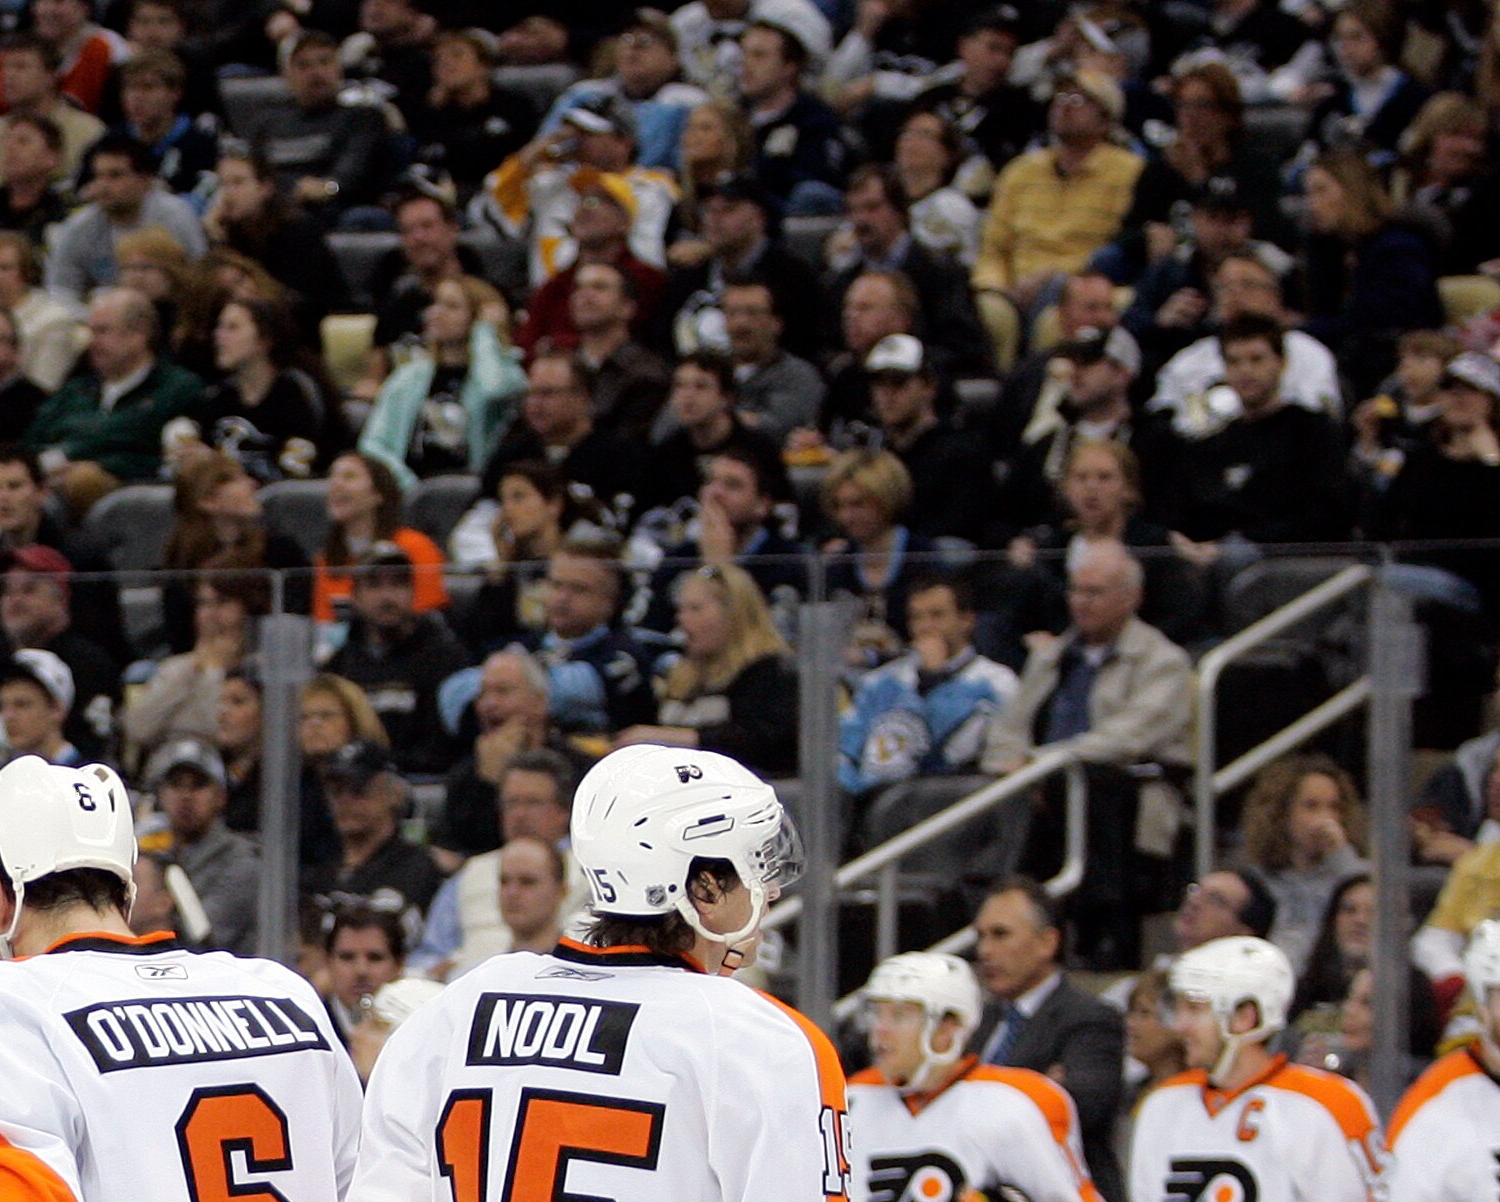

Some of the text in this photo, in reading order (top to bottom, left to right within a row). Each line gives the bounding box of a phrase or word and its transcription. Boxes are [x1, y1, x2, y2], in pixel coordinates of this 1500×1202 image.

[73, 783, 96, 811] 6
[87, 999, 319, 1062] O'DONNELL
[483, 999, 606, 1066] NODL
[1237, 1098, 1266, 1142] C
